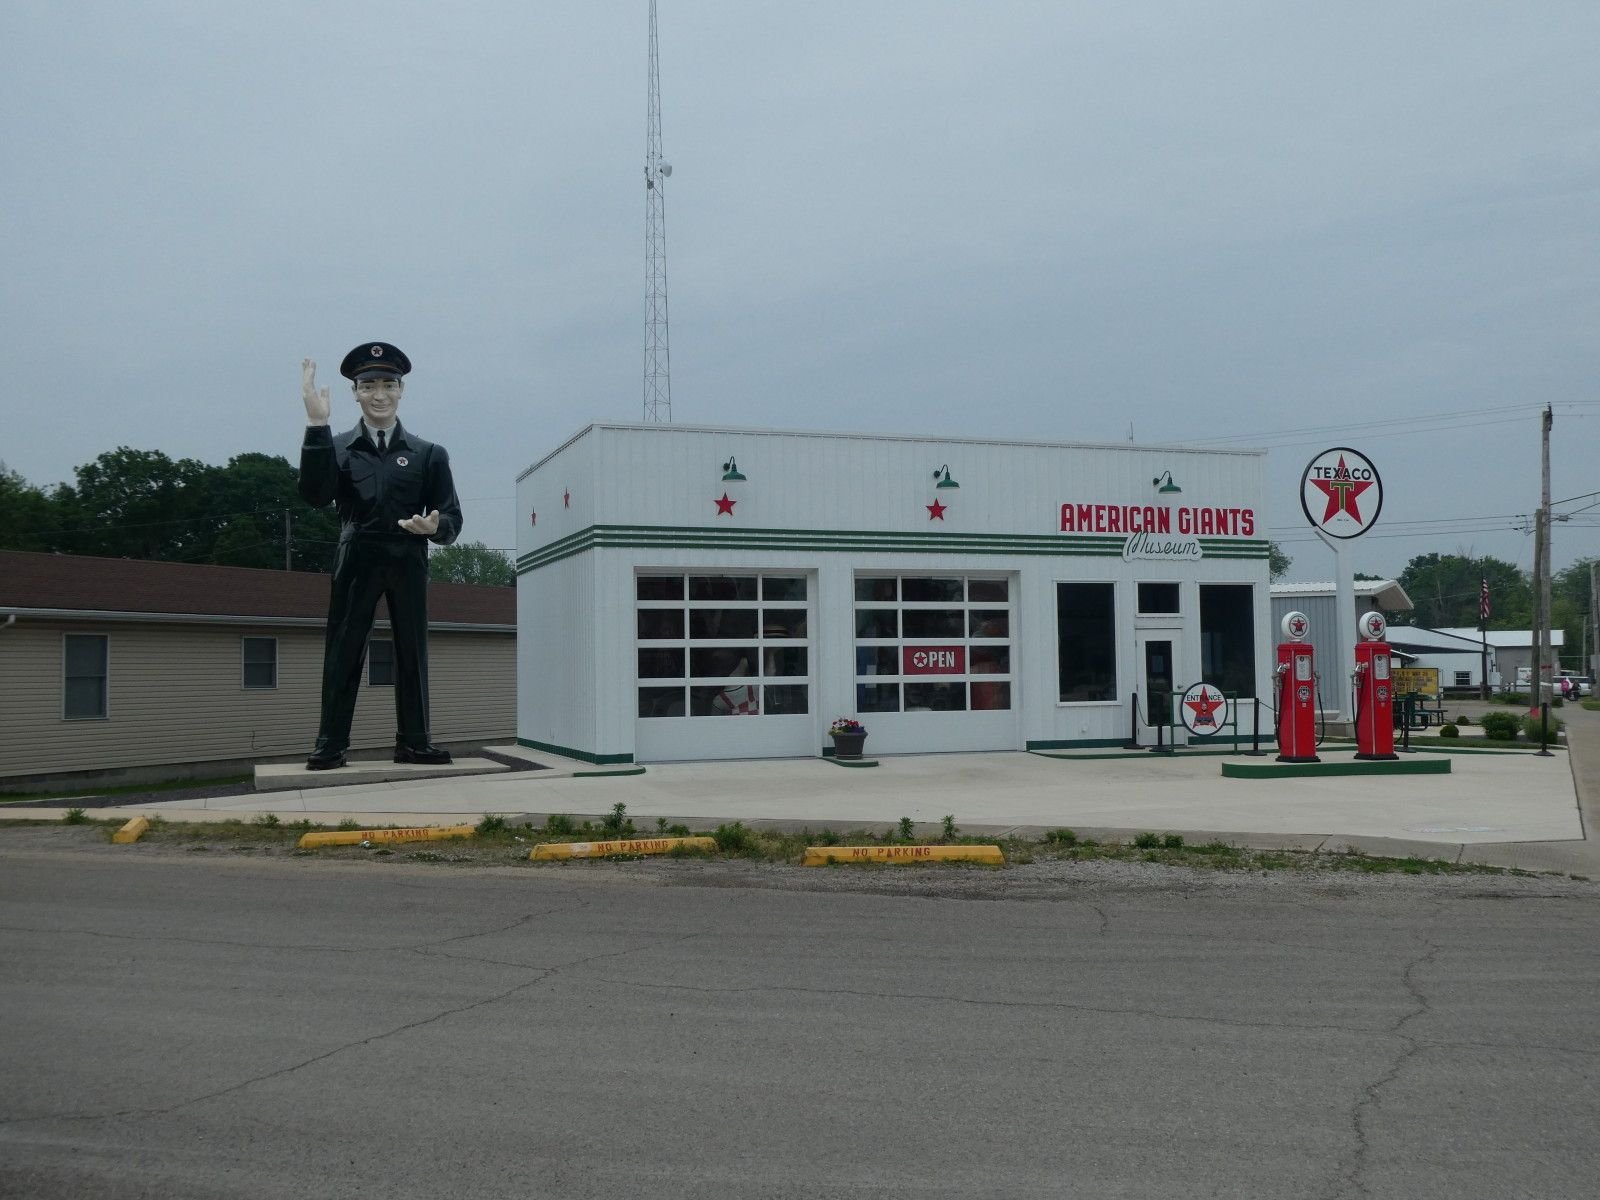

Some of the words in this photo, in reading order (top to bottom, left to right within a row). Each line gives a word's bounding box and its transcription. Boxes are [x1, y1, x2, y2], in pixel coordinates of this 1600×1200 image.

[1314, 466, 1371, 480] TEXACO
[1060, 503, 1171, 534] AMERICAN
[1178, 506, 1254, 536] GIANTS
[1126, 529, 1199, 557] Museum
[913, 651, 955, 668] OPEN
[1186, 694, 1222, 702] ENTNCE
[383, 829, 429, 839] PARKING
[598, 843, 612, 853] NO
[620, 840, 669, 851] PARKING
[852, 848, 868, 857] NO
[877, 847, 931, 857] PARKING
